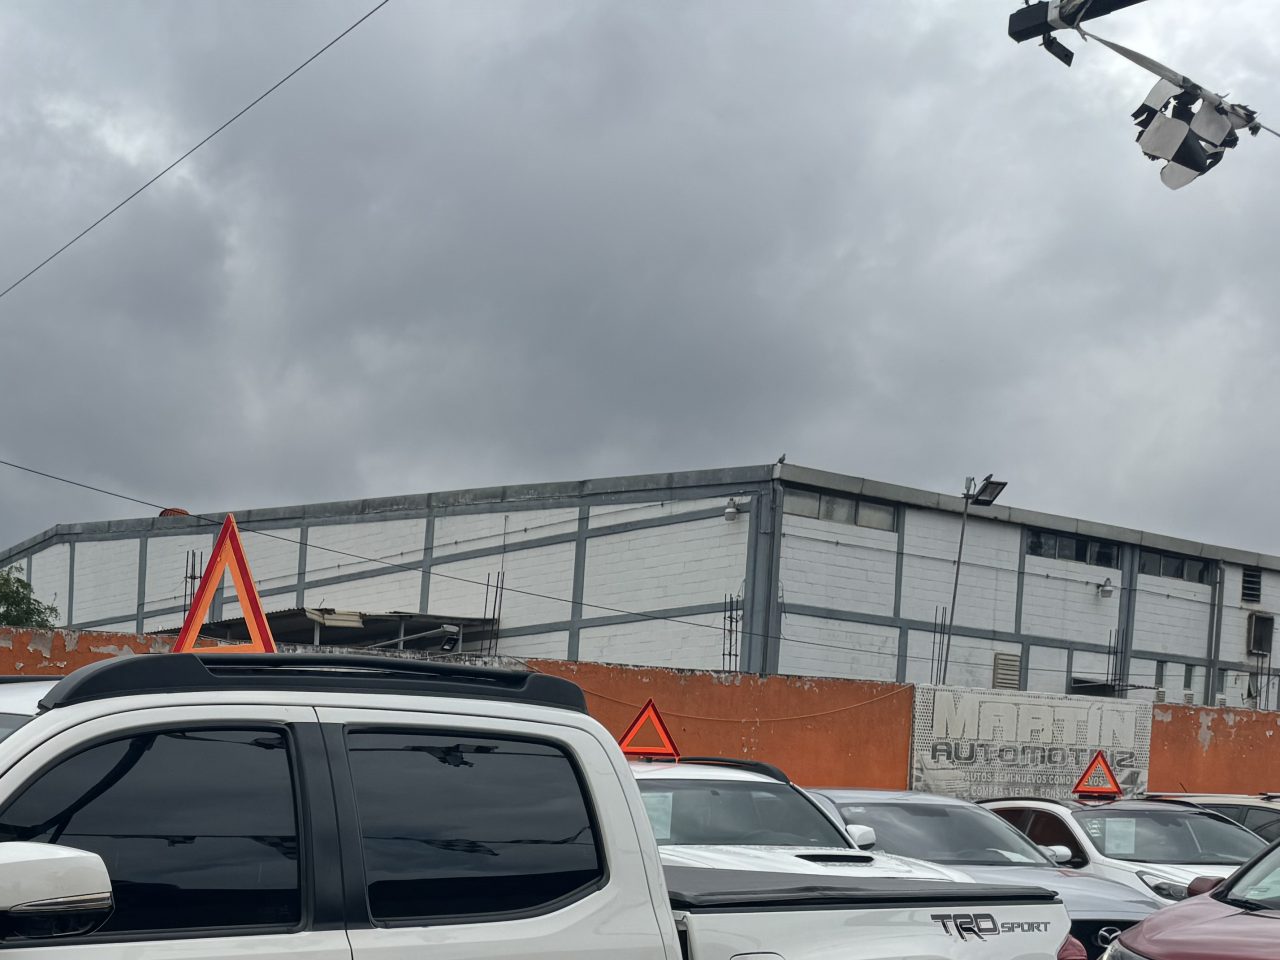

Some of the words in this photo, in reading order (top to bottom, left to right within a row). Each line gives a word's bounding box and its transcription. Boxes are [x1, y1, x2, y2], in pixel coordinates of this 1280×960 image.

[965, 772, 992, 782] AUTOS
[994, 773, 1047, 784] SEMI-NUEVOS
[1049, 775, 1070, 785] COMO
[971, 786, 1003, 797] COMPRA
[1009, 787, 1034, 798] VENTA
[931, 914, 1000, 942] TRD
[1001, 922, 1051, 933] SPORT
